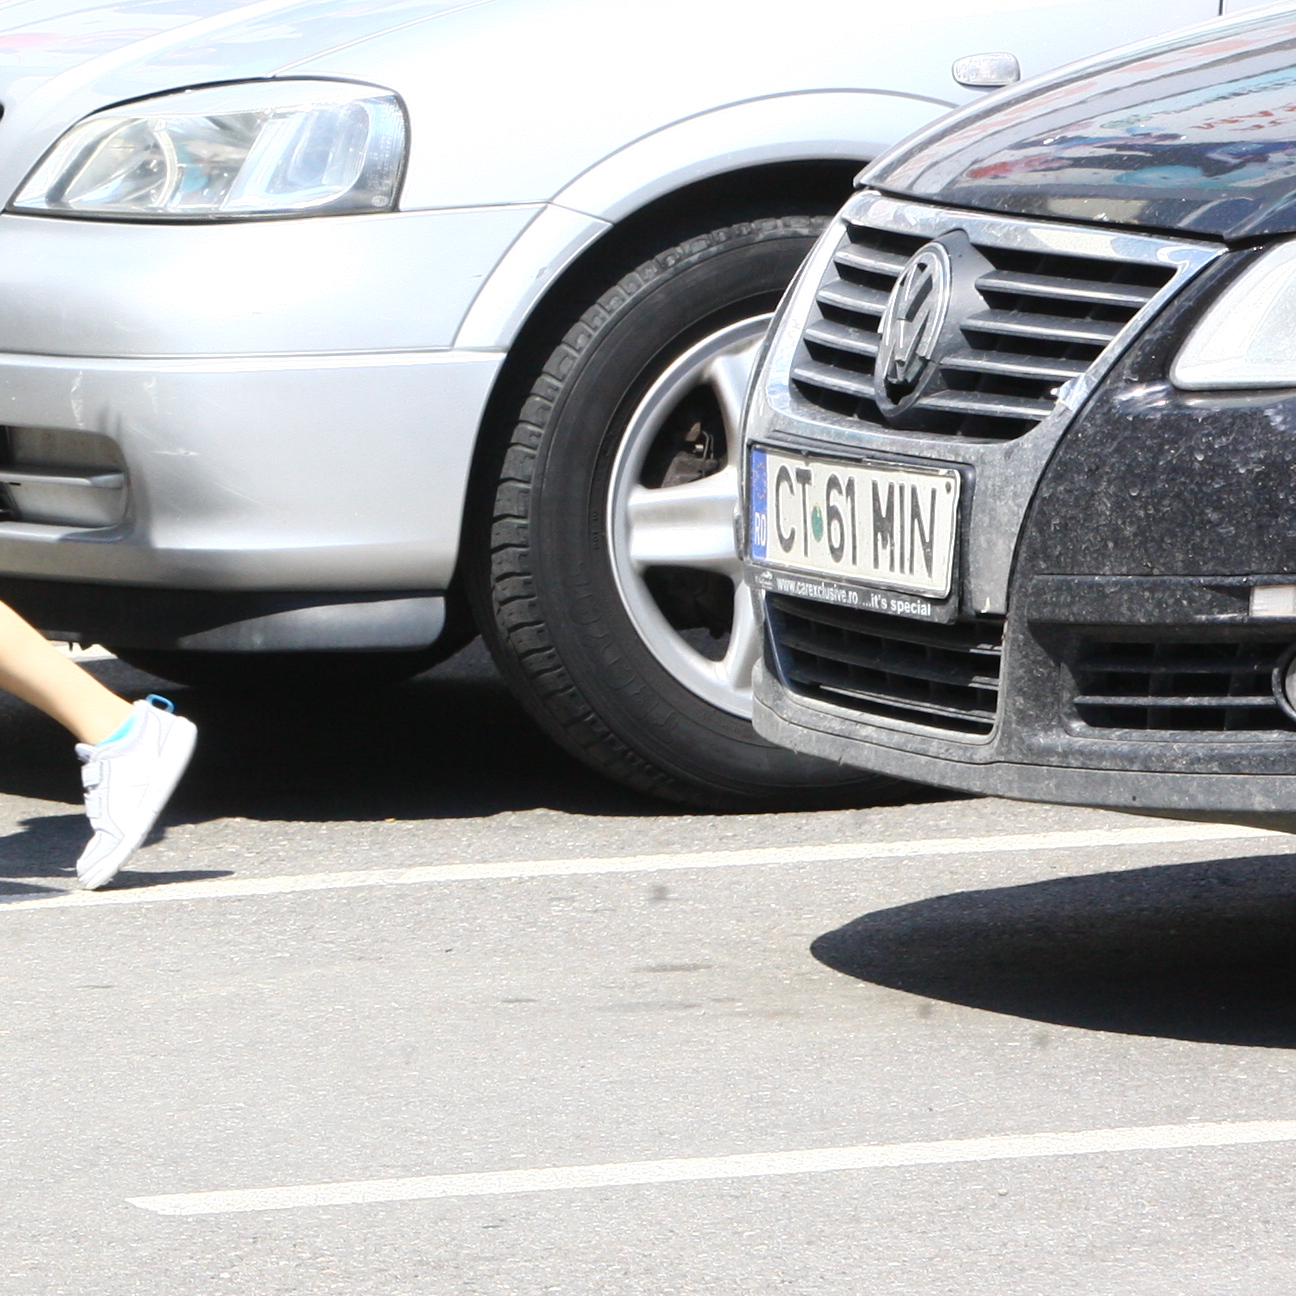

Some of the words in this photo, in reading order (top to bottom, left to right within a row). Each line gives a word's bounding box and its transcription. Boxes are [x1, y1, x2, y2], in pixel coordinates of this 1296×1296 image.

[754, 512, 766, 546] RO
[775, 465, 812, 557] CT
[825, 473, 857, 566] 61
[871, 478, 937, 578] MIN
[890, 599, 931, 616] special
